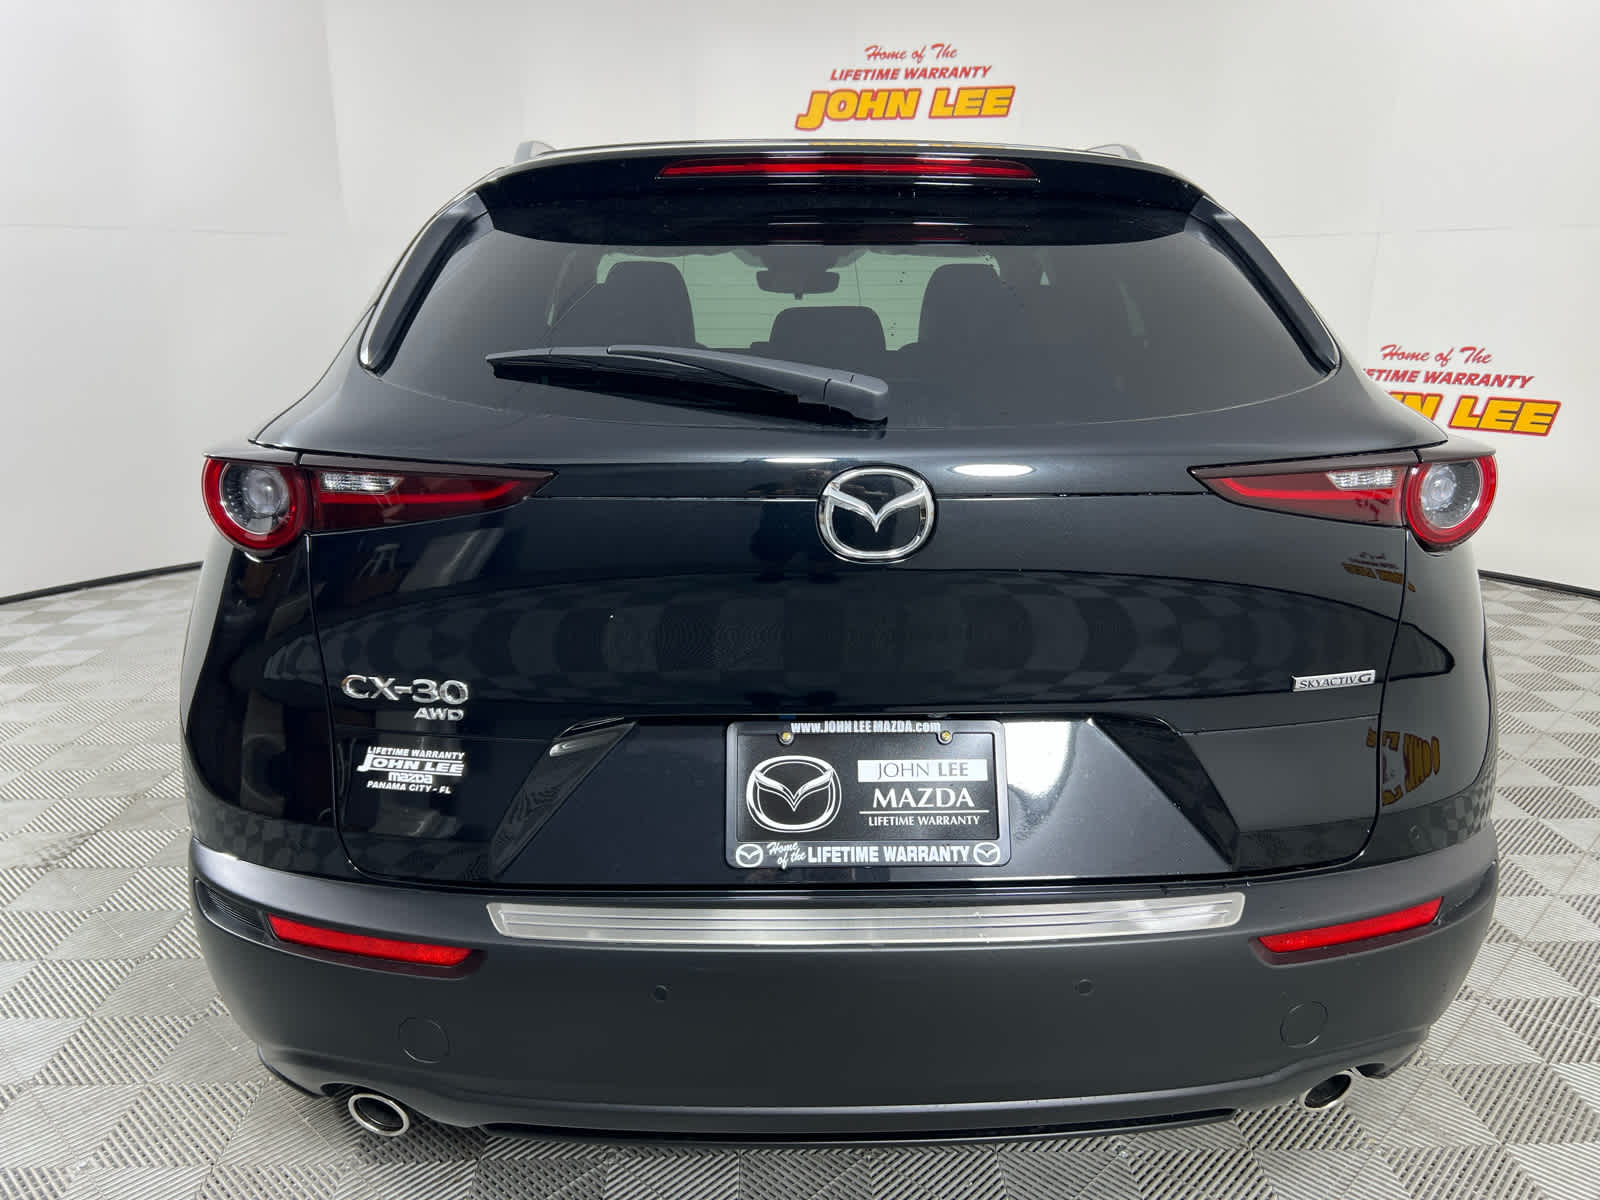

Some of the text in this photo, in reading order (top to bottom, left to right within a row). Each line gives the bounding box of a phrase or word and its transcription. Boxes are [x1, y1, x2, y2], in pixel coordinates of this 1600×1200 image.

[864, 43, 957, 64] Home of The
[830, 65, 992, 81] LIFETIME WARRANTY
[795, 86, 1016, 131] JOHN LEE
[1380, 344, 1493, 367] Home of The
[1423, 370, 1535, 389] WARRANTY
[1448, 395, 1562, 437] LEE
[341, 674, 469, 705] CX-30
[414, 707, 464, 721] AWD
[367, 746, 465, 760] LIFETIME WARRANTY
[357, 754, 465, 774] JOHN LEE
[877, 762, 969, 780] JOHN LEE
[366, 780, 406, 791] PANAMA
[408, 784, 432, 793] CITY
[439, 786, 452, 794] FL
[872, 787, 975, 808] MAZDA
[868, 815, 980, 827] LIFETIME WARRANTY
[766, 842, 799, 856] Home
[807, 845, 970, 863] LIFETIME WARRANTY
[777, 851, 807, 871] of the
